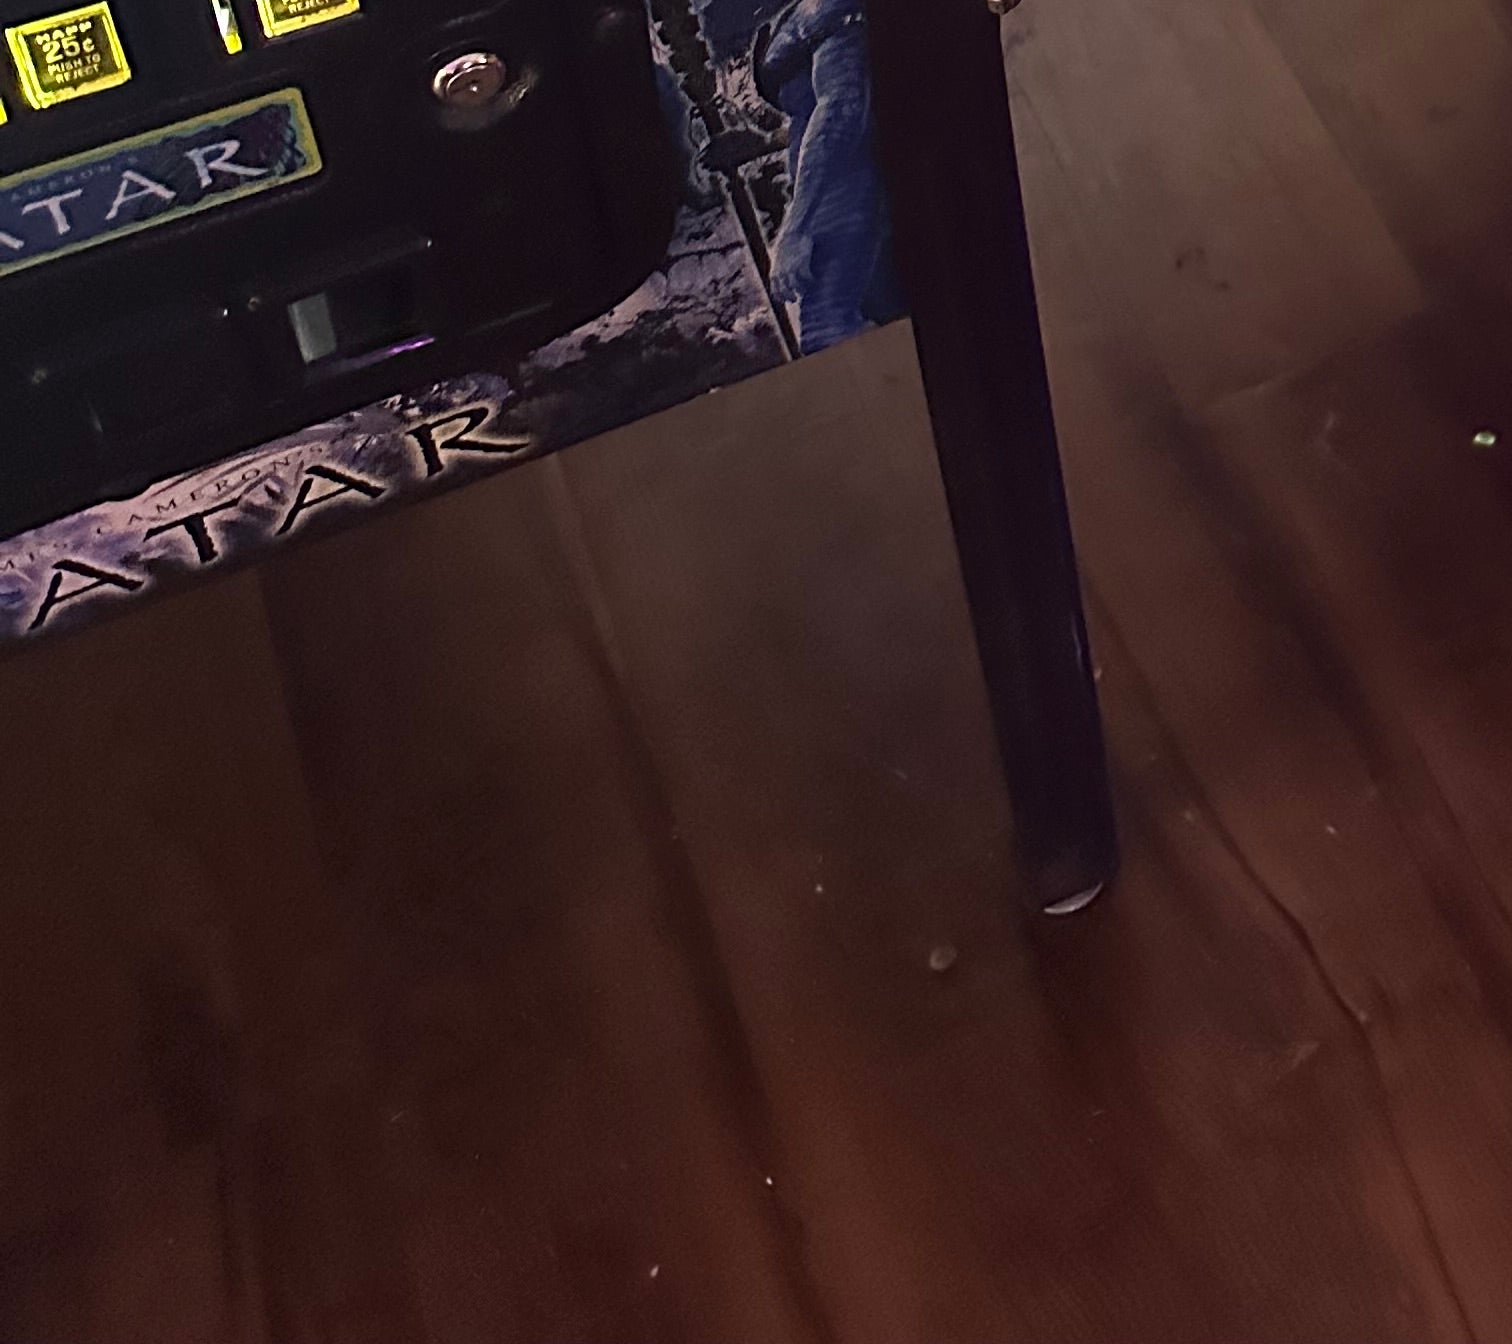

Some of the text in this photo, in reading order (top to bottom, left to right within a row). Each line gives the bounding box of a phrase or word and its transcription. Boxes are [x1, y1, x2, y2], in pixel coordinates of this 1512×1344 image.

[41, 36, 97, 64] 25¢
[47, 52, 102, 78] PUSH TO
[55, 64, 101, 85] REJECT
